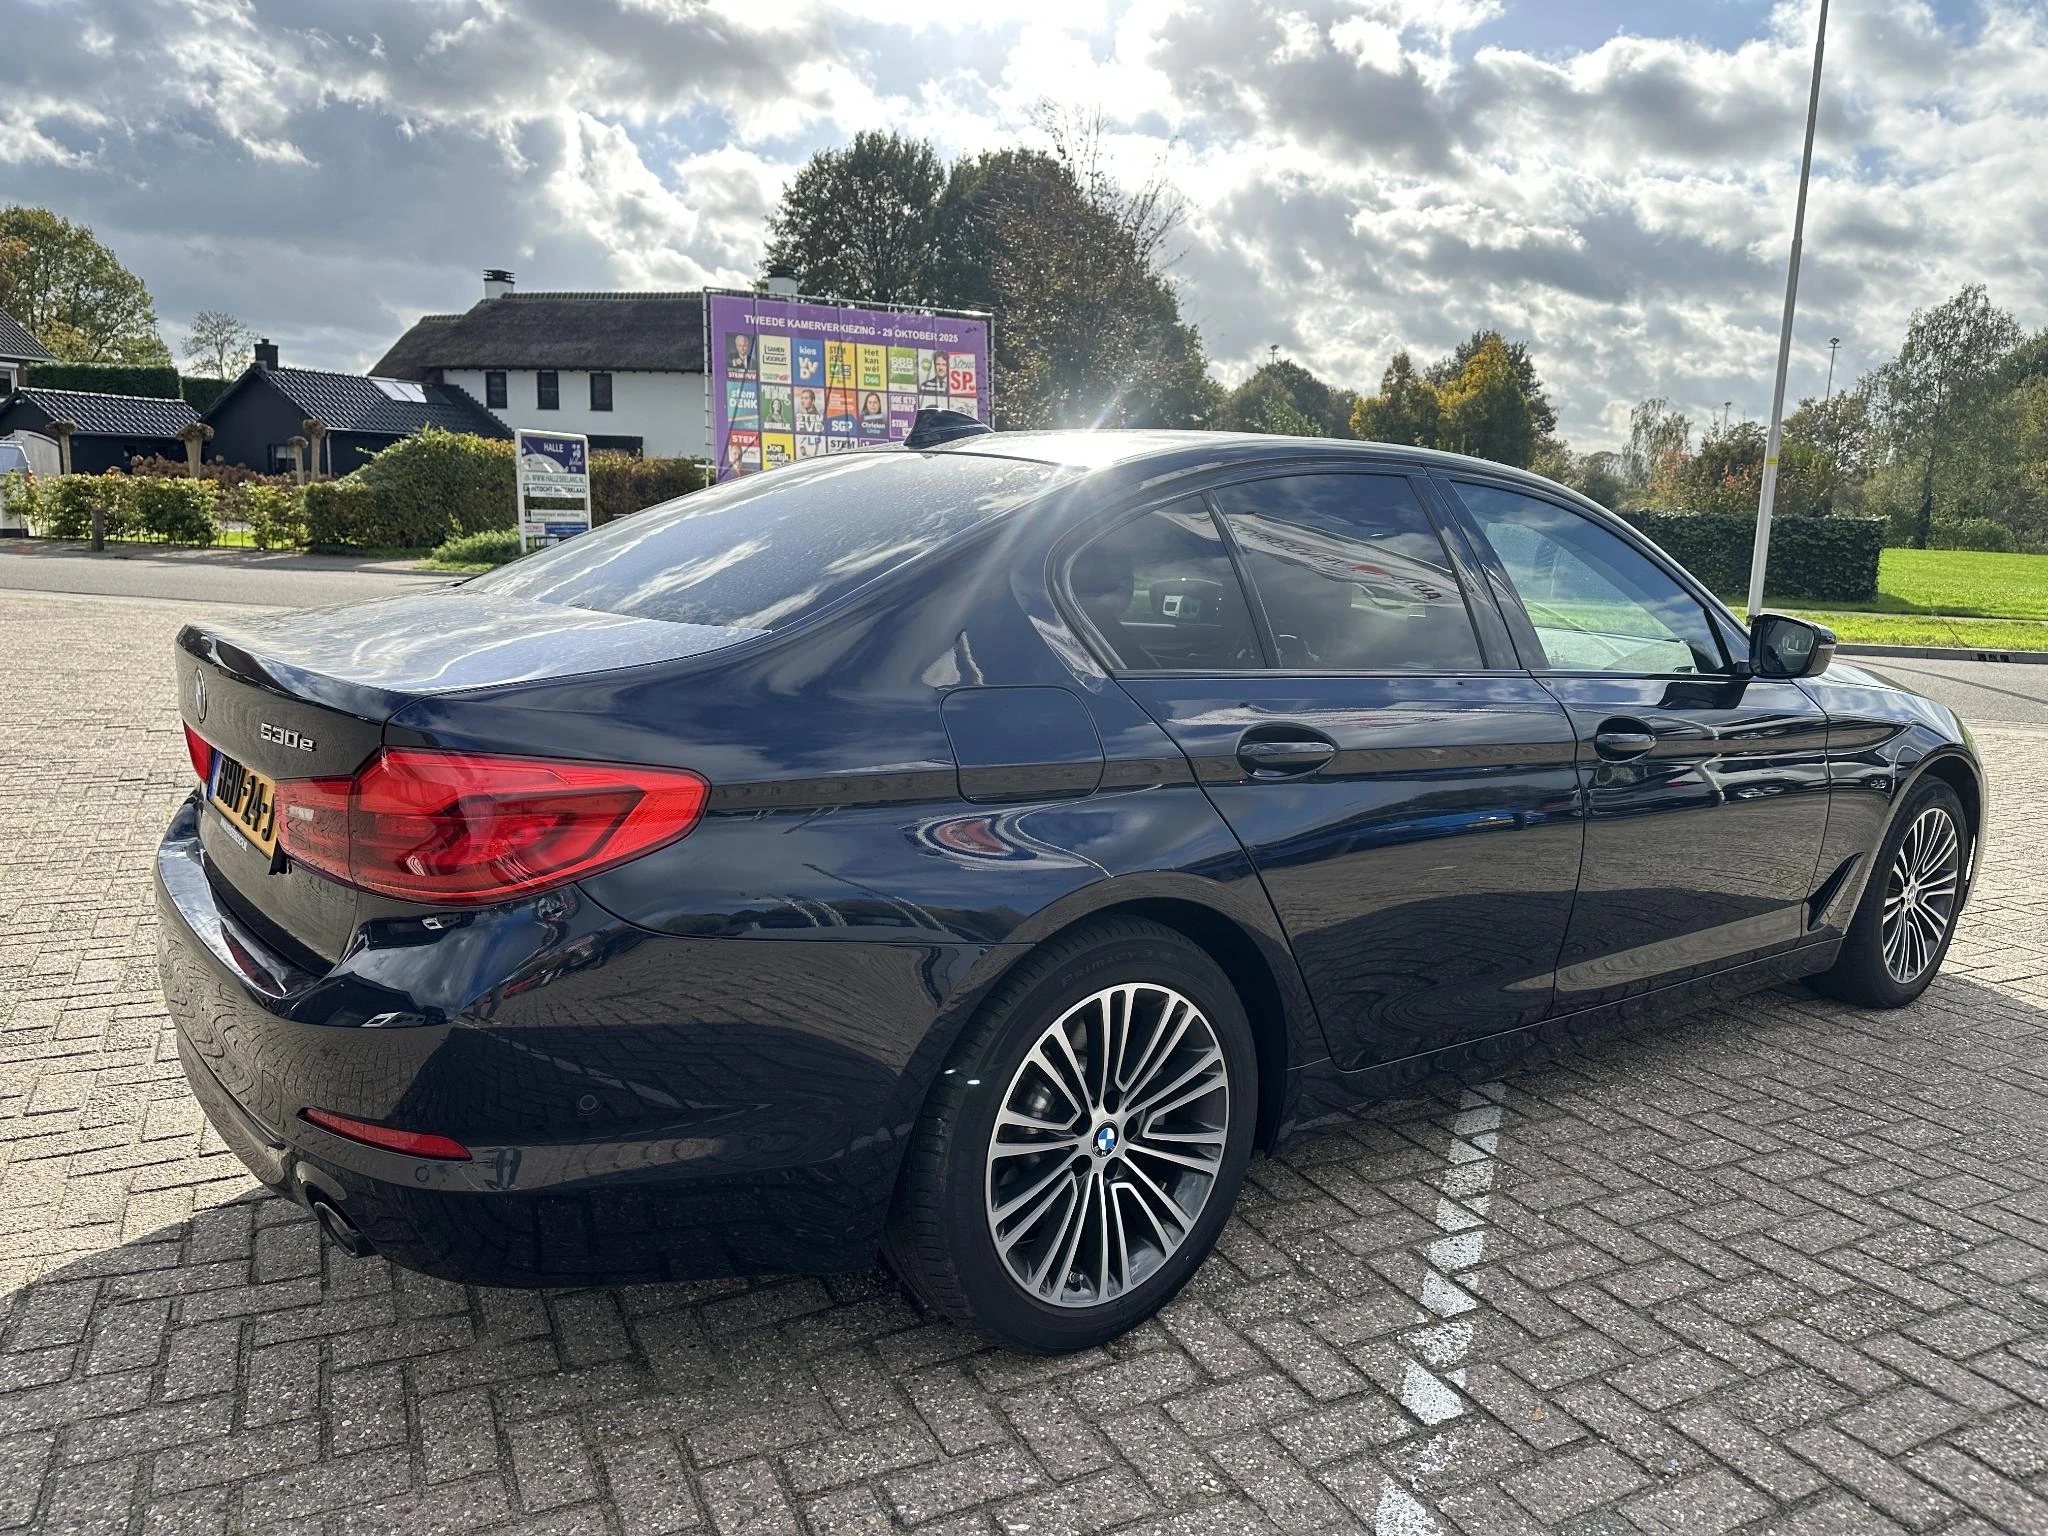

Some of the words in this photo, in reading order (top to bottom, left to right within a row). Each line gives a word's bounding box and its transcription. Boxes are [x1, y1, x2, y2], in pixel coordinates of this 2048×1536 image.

[744, 314, 786, 328] TWEEDE
[787, 318, 876, 336] KAMERVERKIEZING
[882, 327, 893, 338] 29
[894, 328, 938, 342] OKTOBER
[939, 332, 959, 344] 2025
[864, 349, 880, 357] Het
[864, 357, 880, 365] kan
[730, 388, 756, 399] stem
[729, 398, 758, 410] DENK
[543, 442, 564, 453] HALLE
[260, 722, 315, 752] 530e
